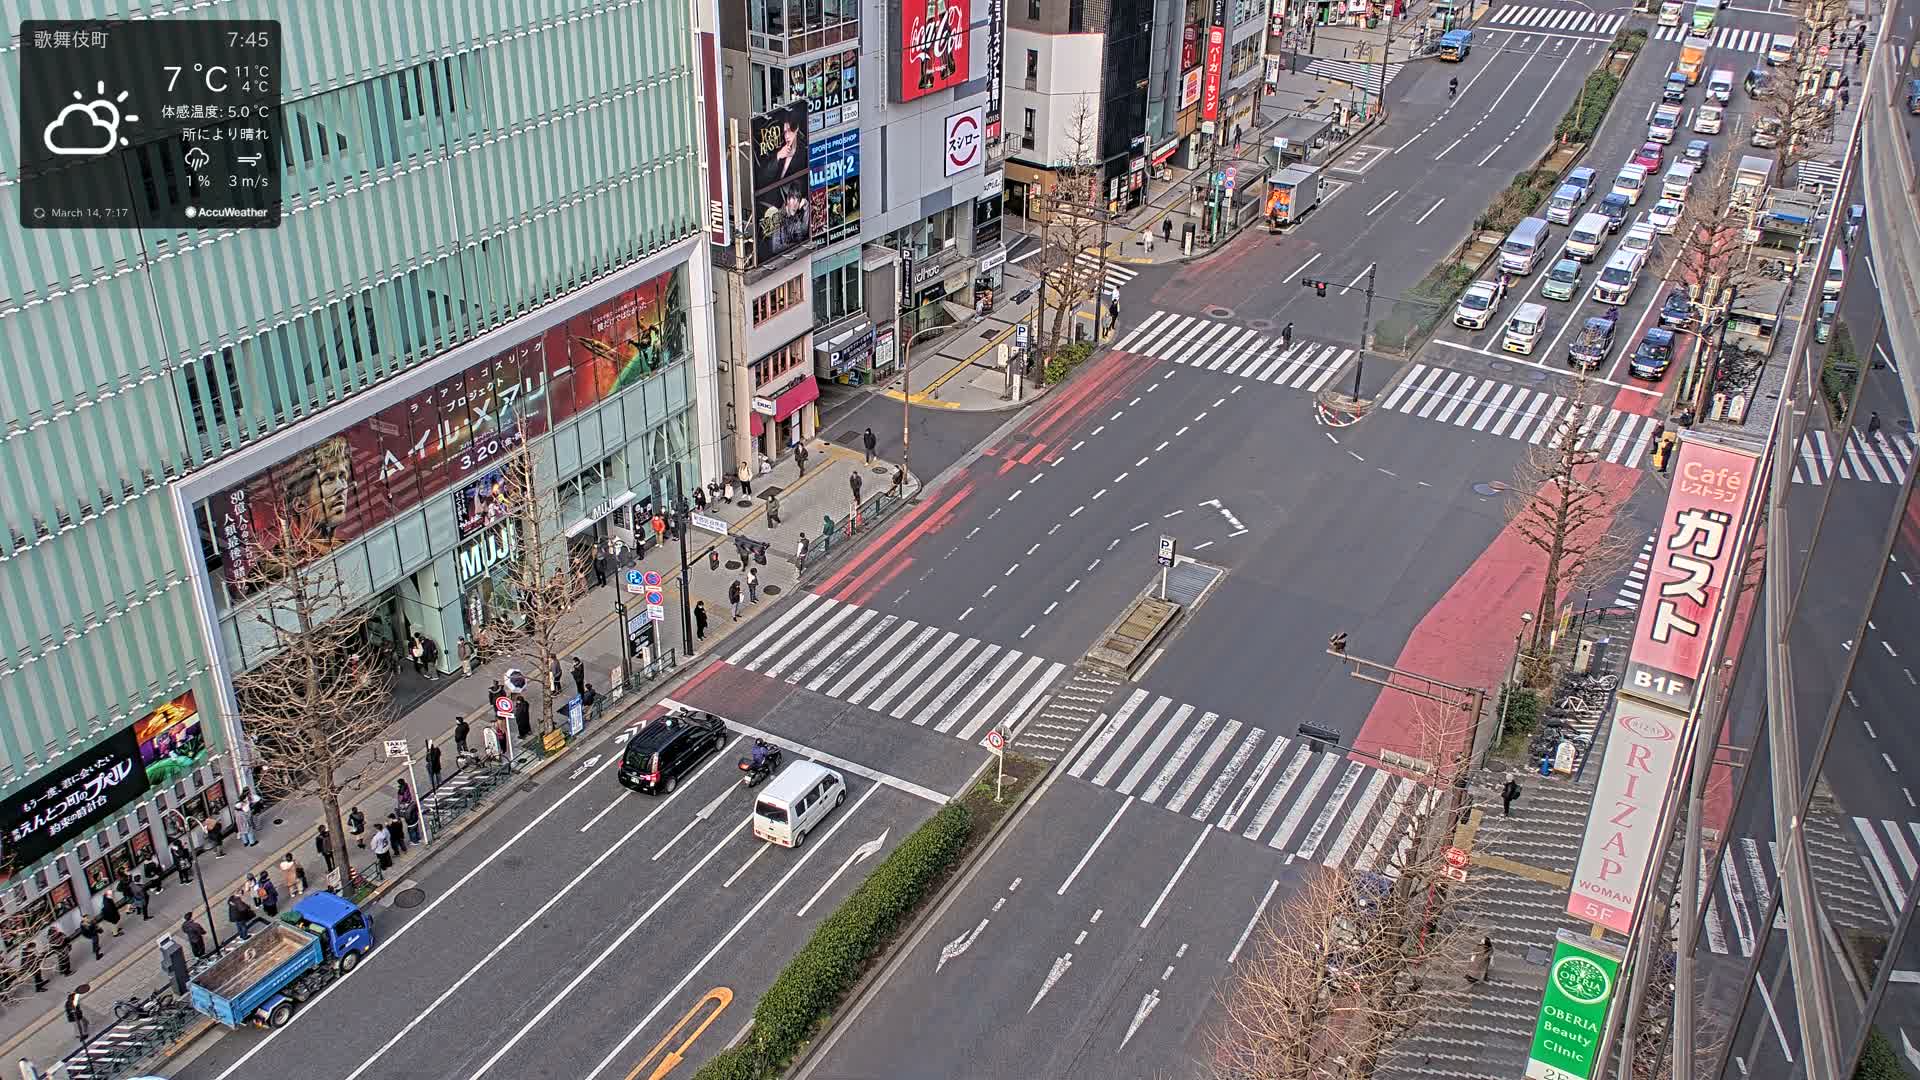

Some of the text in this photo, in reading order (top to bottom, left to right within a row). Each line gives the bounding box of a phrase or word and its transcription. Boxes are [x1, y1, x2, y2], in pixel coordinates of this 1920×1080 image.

[1206, 46, 1221, 111] バーガーキング
[948, 134, 980, 153] スシロー
[711, 199, 724, 233] MUJI
[410, 342, 543, 414] ライアン・ゴズリング
[447, 378, 504, 413] プロジェクト
[1683, 462, 1742, 491] Café
[1680, 480, 1737, 503] レストラン
[592, 497, 615, 520] MUJI
[459, 519, 519, 583] MUJI
[1651, 507, 1732, 643] ガスト
[1634, 670, 1684, 696] B1F
[20, 757, 132, 838] えんとつ町のプペル
[23, 754, 115, 813] もう一度、君に会いたい
[49, 795, 107, 837] 約束の時計台
[1599, 743, 1652, 881] RIZAP
[1579, 879, 1633, 905] WOMAN
[1585, 903, 1614, 921] 5F
[1560, 971, 1601, 992] OBERIA
[1544, 1005, 1598, 1033] OBERIA
[1544, 1020, 1592, 1048] Beauty
[1543, 1039, 1584, 1063] Clinic
